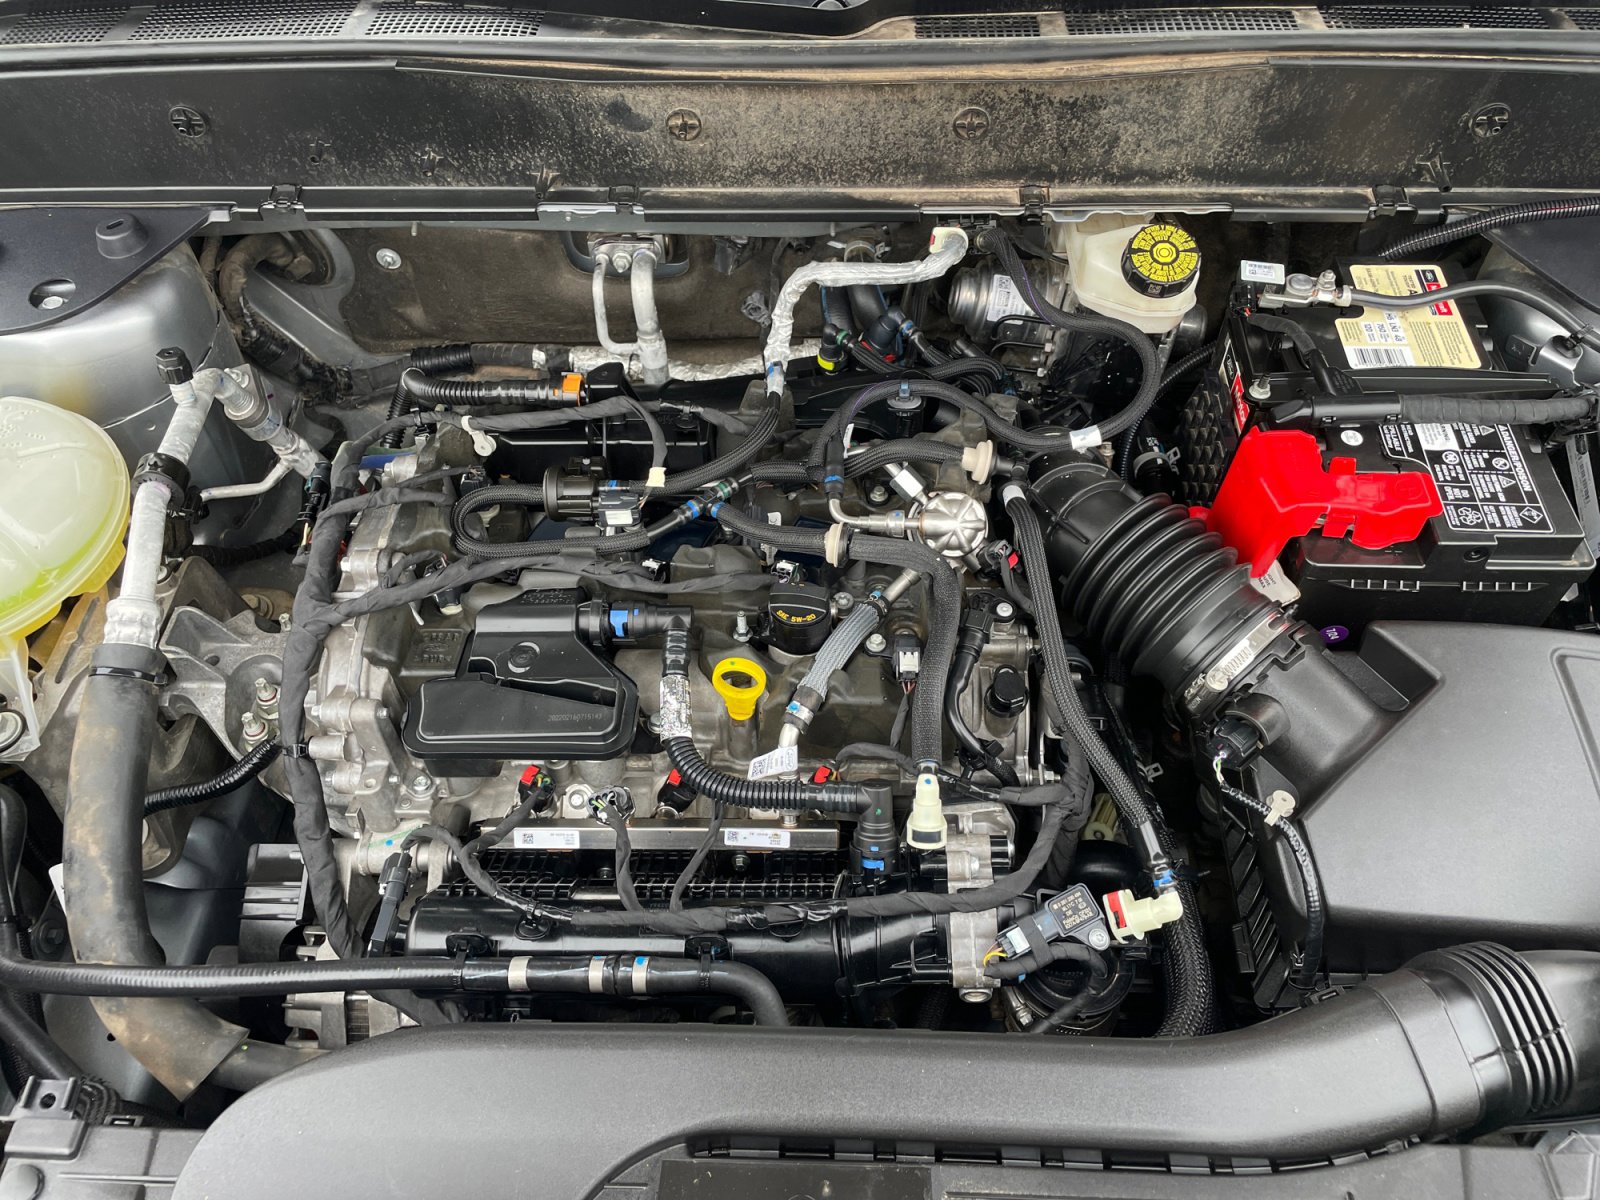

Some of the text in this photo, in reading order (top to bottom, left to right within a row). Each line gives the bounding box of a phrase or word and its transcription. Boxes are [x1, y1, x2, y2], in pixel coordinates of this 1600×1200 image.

[1387, 424, 1401, 450] SPILLABLE
[1500, 431, 1532, 491] DANGER/POISON
[776, 610, 816, 623] SAE 5W-20
